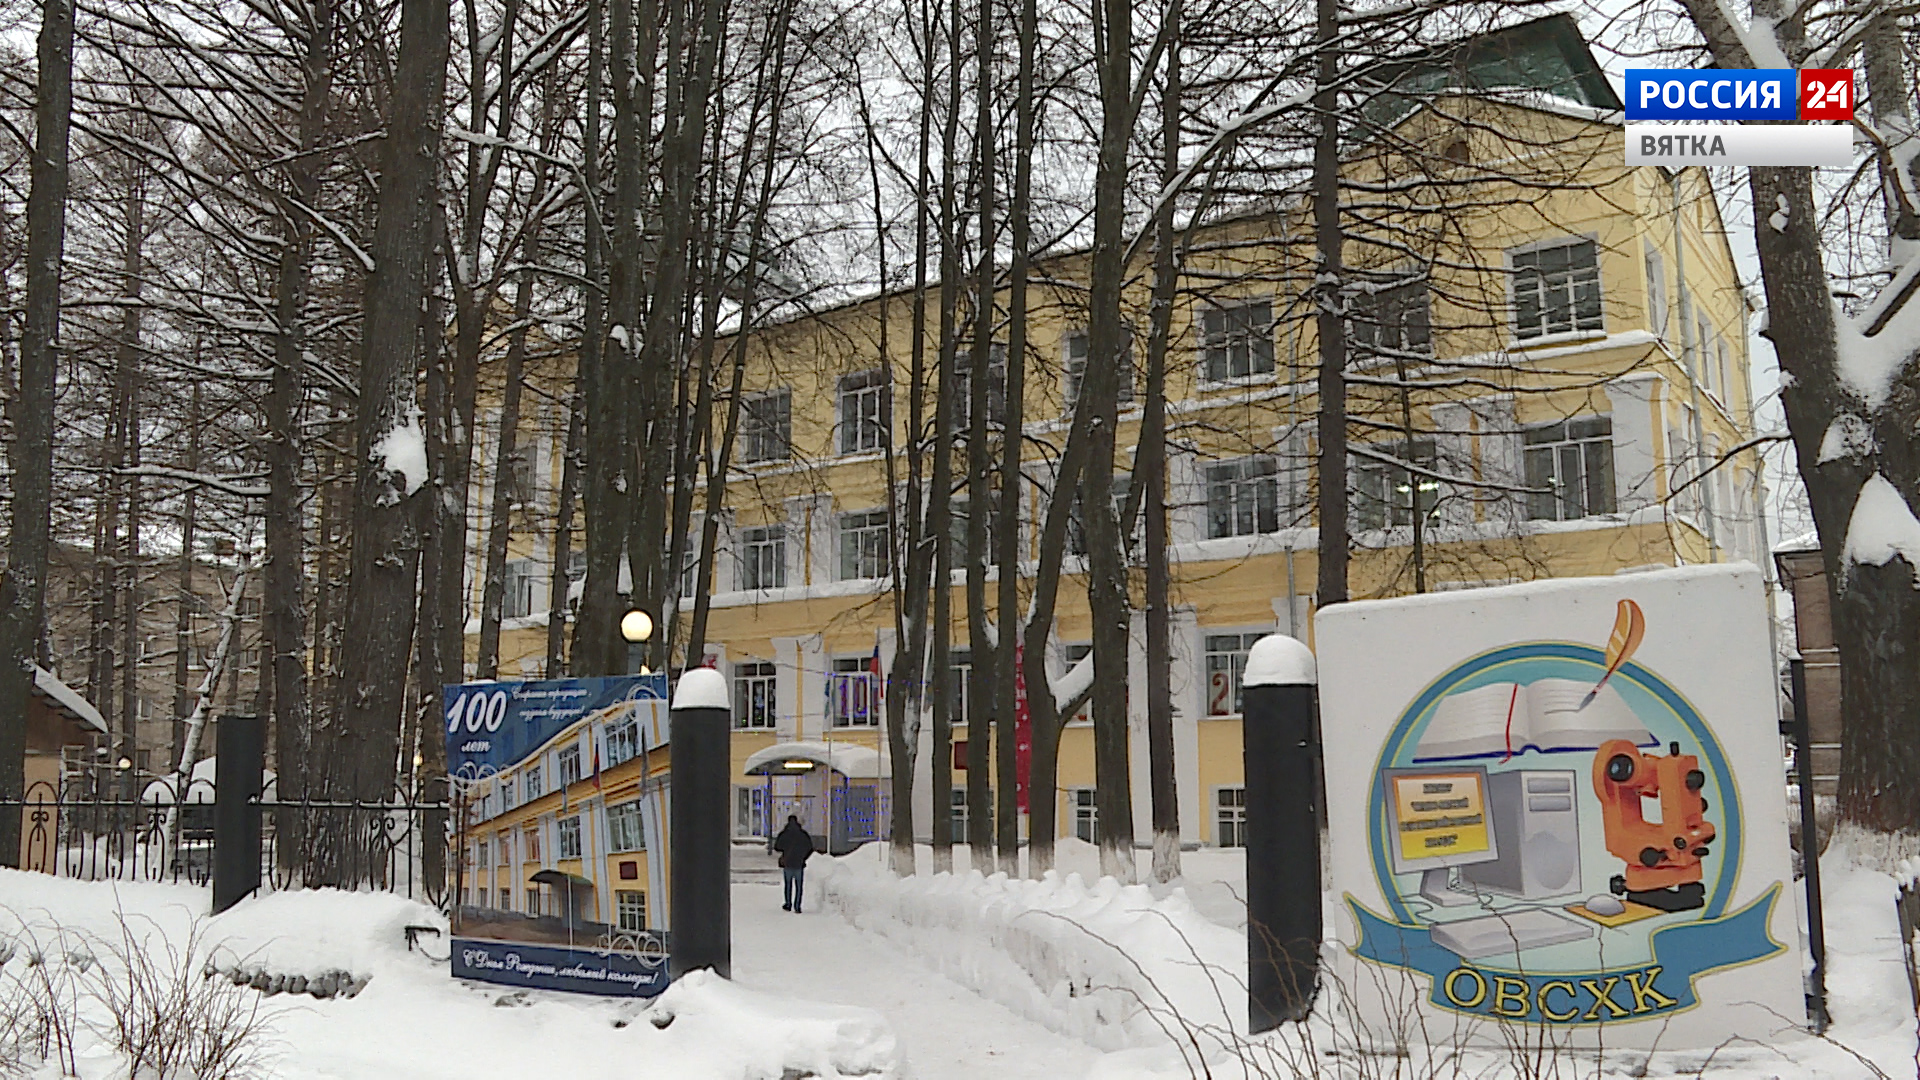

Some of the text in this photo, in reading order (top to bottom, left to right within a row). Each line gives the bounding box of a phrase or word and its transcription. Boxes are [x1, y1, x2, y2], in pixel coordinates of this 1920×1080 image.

[447, 690, 507, 733] 100
[1212, 672, 1229, 716] 2
[461, 741, 492, 752] лет
[463, 949, 474, 968] С
[1443, 965, 1679, 1022] ОВСХК
